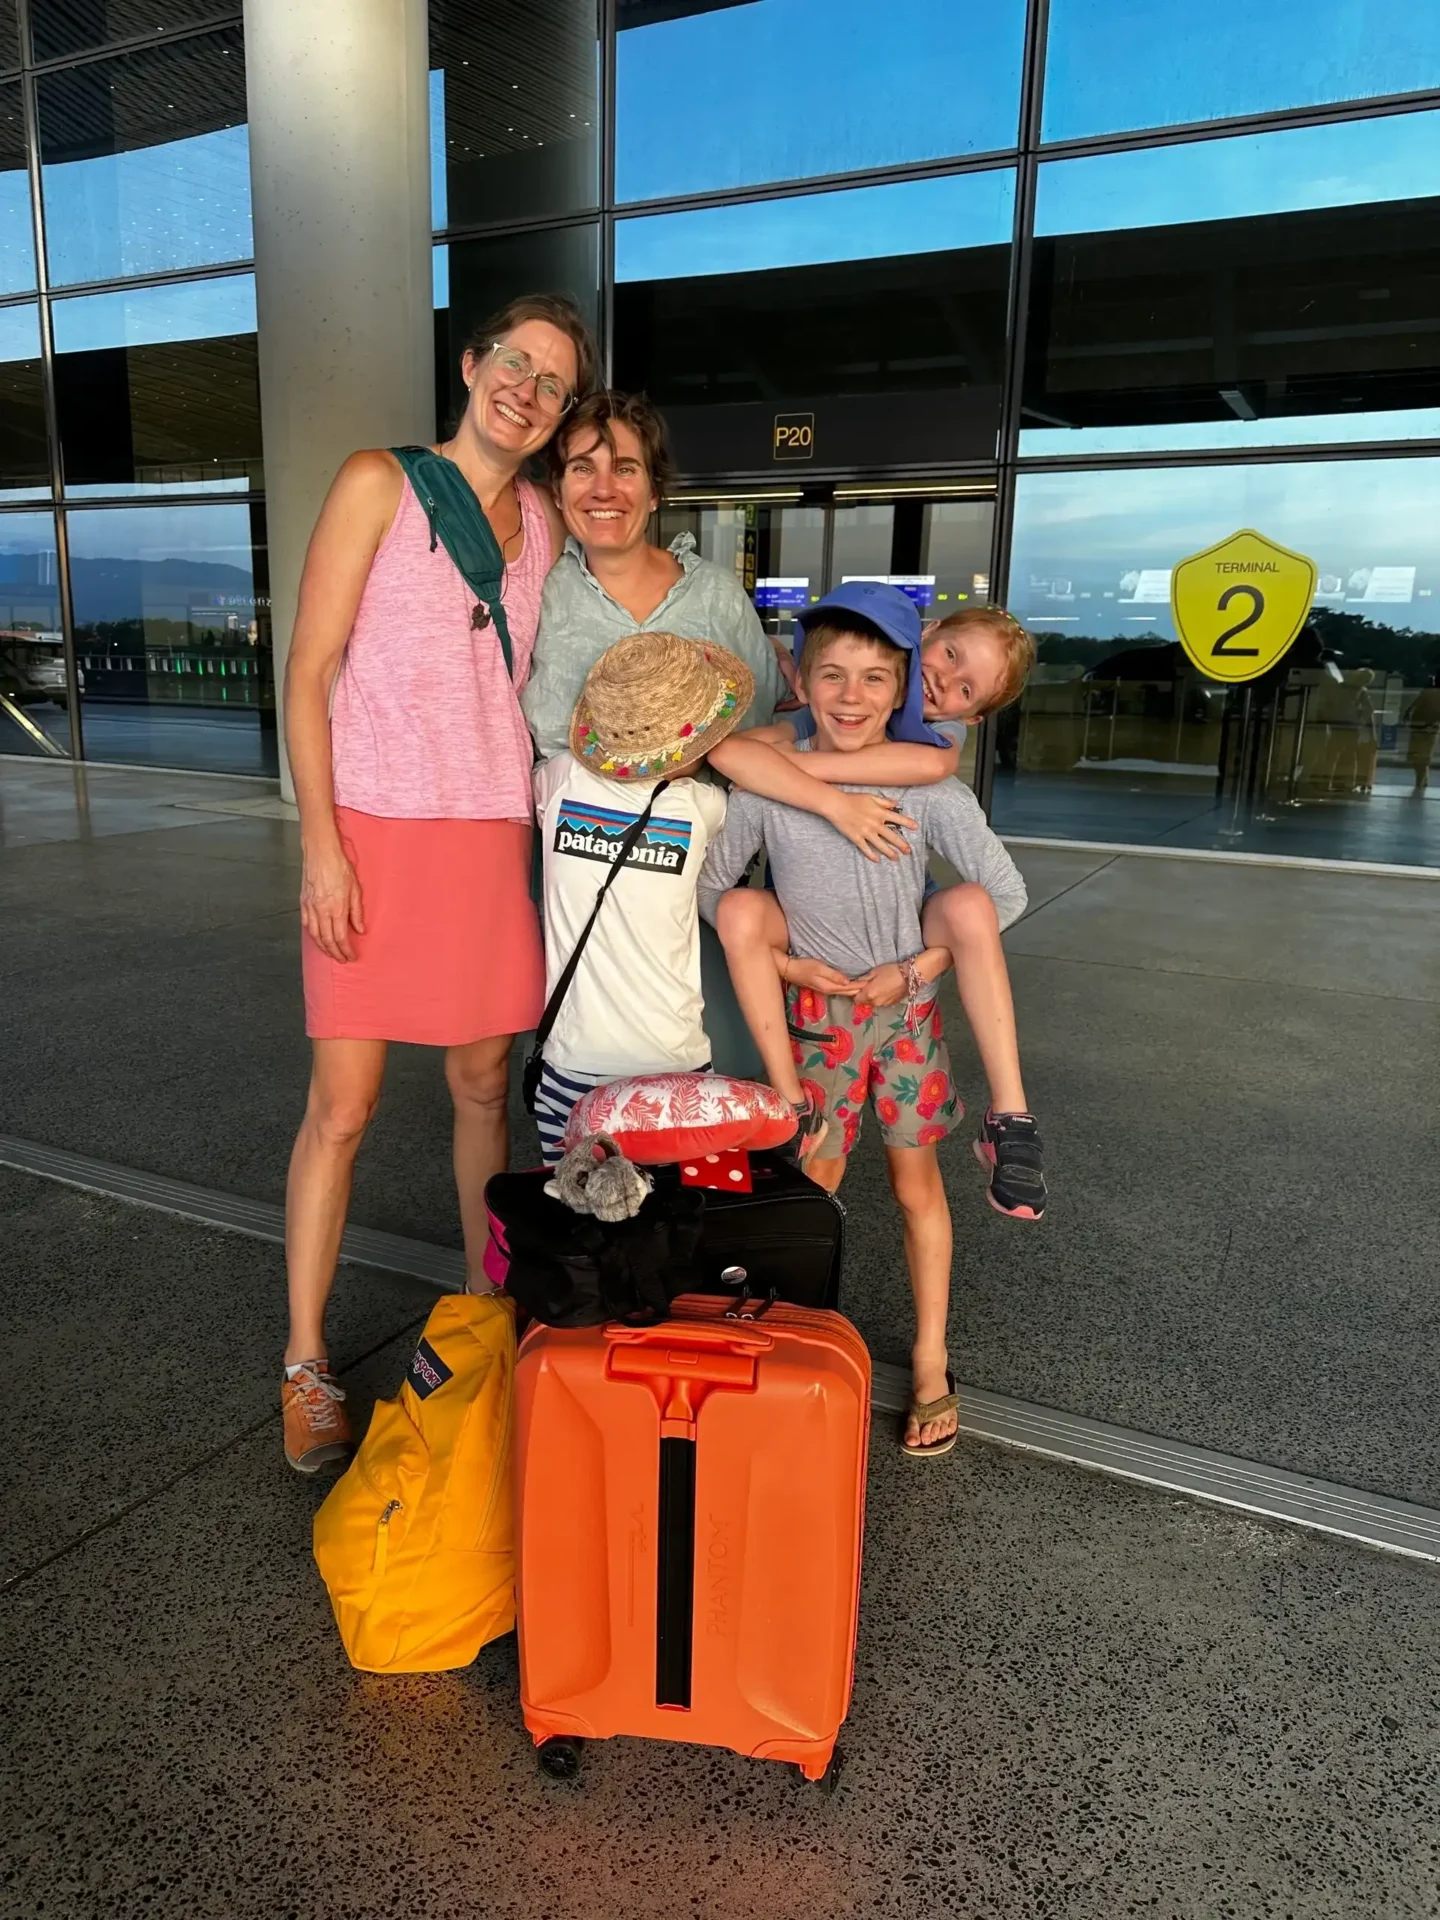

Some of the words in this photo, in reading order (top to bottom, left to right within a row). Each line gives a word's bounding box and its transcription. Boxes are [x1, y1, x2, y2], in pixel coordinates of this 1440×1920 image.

[776, 426, 812, 447] P20
[1215, 562, 1280, 574] TERMINAL
[1210, 584, 1266, 657] 2
[706, 1512, 730, 1638] PHANTOM
